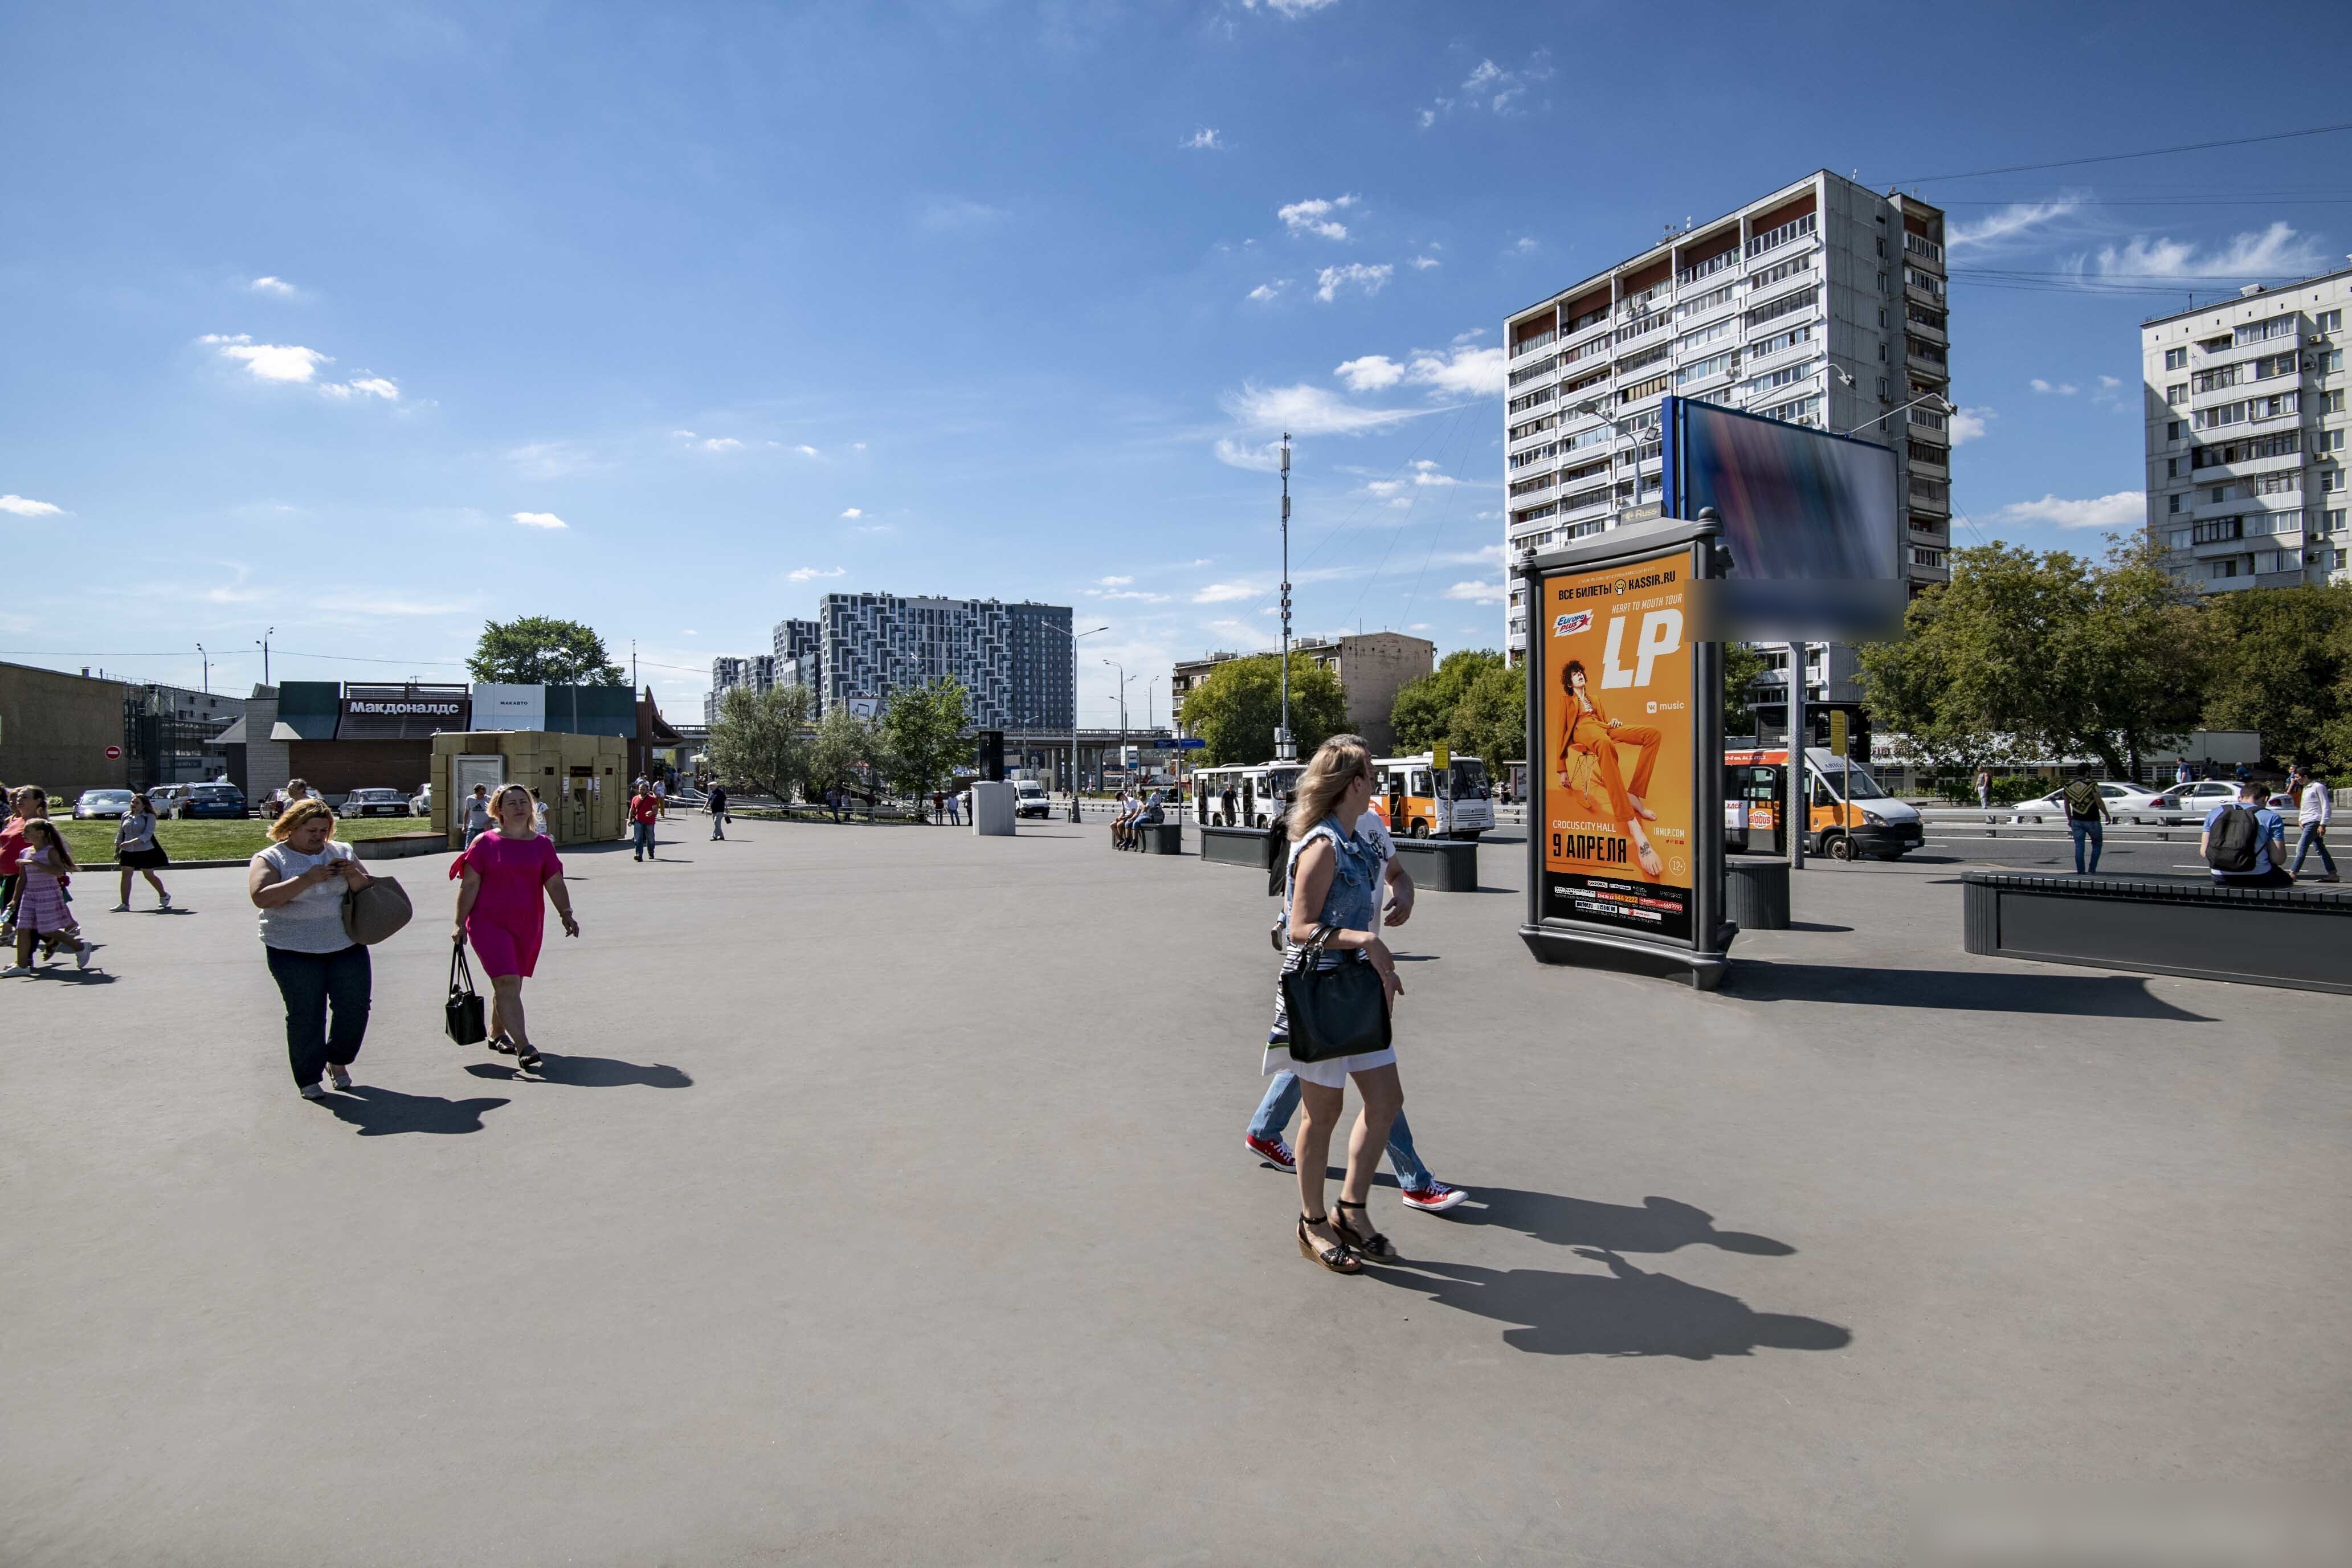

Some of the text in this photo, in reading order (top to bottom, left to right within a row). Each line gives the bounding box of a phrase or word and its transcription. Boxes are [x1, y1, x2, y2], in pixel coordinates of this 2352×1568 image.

[1636, 507, 1657, 517] Russ
[1558, 589, 1574, 601] ВСЕ
[1576, 583, 1612, 598] БИЛЕТЫ
[1628, 570, 1676, 590] KASSIR.RU
[1612, 594, 1683, 614] HEART TO MOUTH TOUR
[1558, 614, 1584, 626] Europa
[1600, 609, 1683, 689] LP
[350, 701, 459, 714] Макдоналдс
[1659, 700, 1685, 710] music
[1553, 820, 1616, 833] CROCUS CITY HALL
[1654, 827, 1685, 838] IAMLP.COM
[1553, 833, 1627, 863] 9 АПРЕЛЯ
[1672, 860, 1684, 871] 12+
